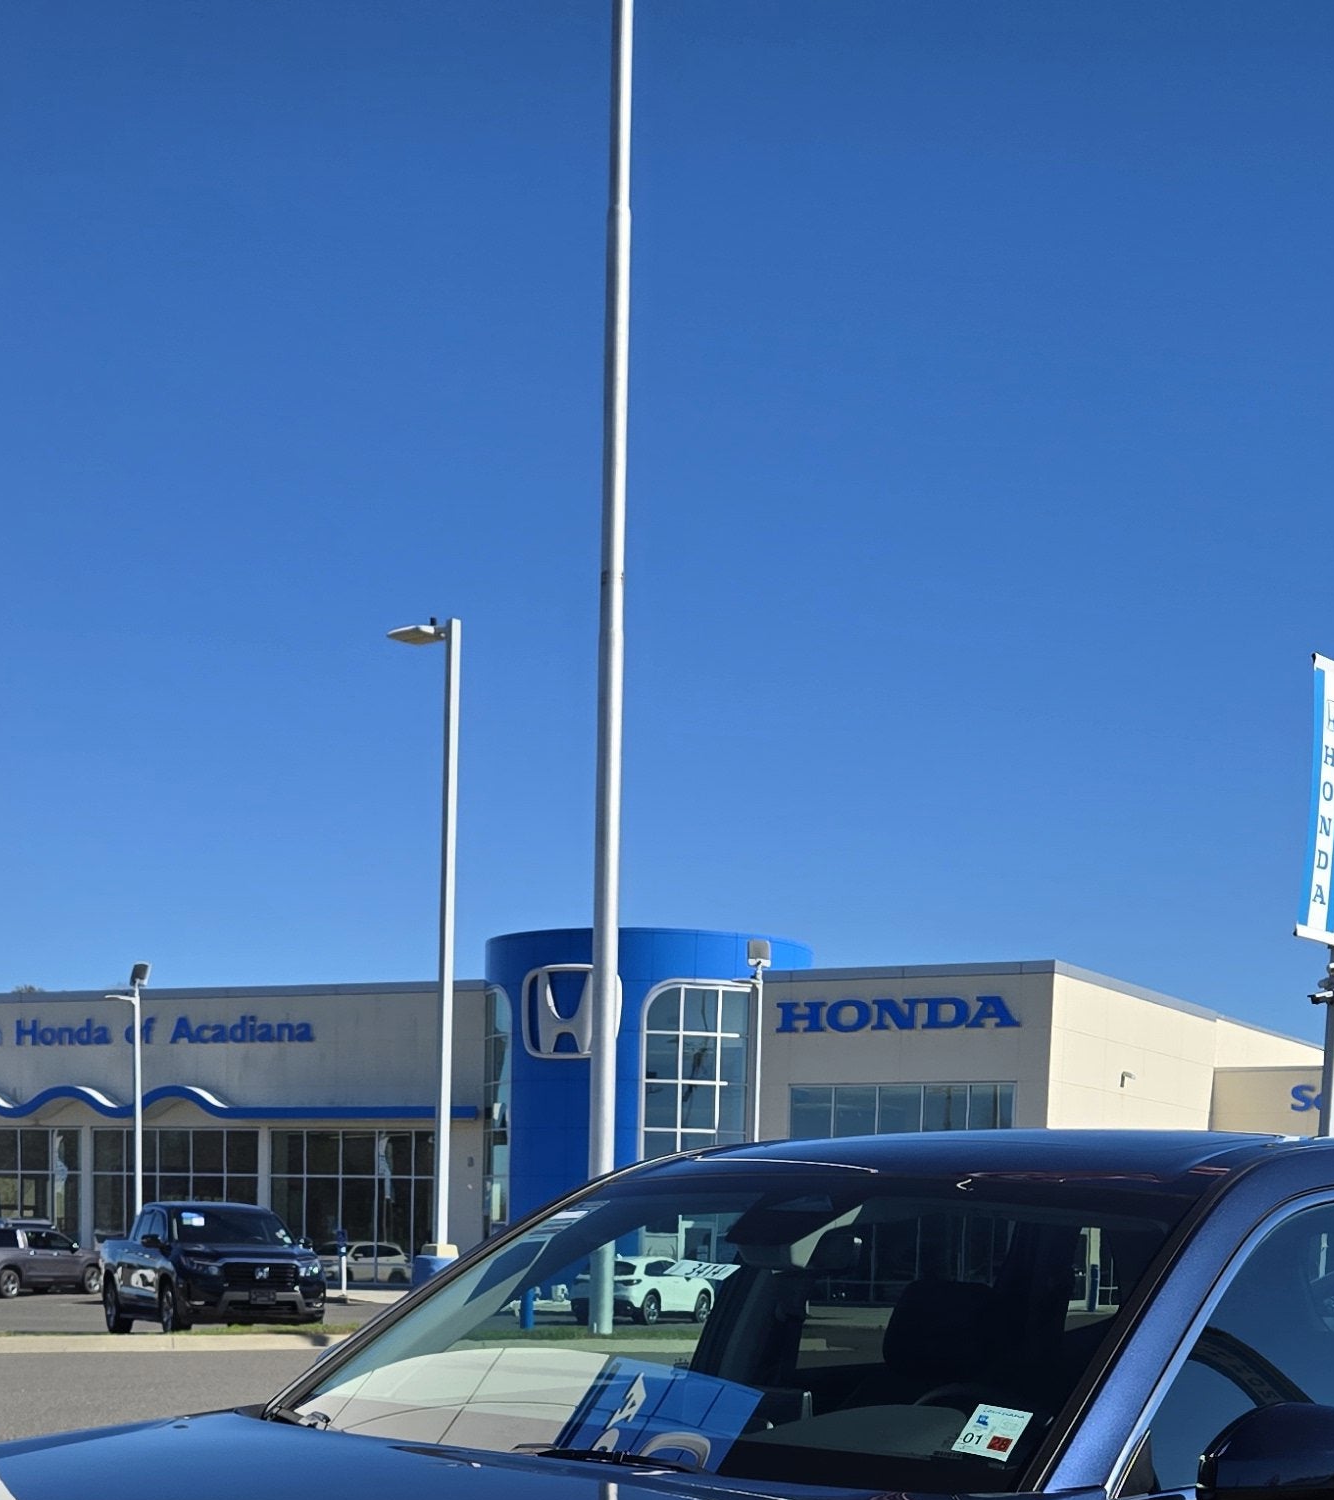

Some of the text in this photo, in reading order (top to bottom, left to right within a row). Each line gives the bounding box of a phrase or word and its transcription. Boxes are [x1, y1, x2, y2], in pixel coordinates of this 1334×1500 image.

[776, 995, 1021, 1033] HONDA
[15, 1017, 112, 1046] Honda
[170, 1015, 315, 1045] Acadiana
[963, 1432, 983, 1445] 01
